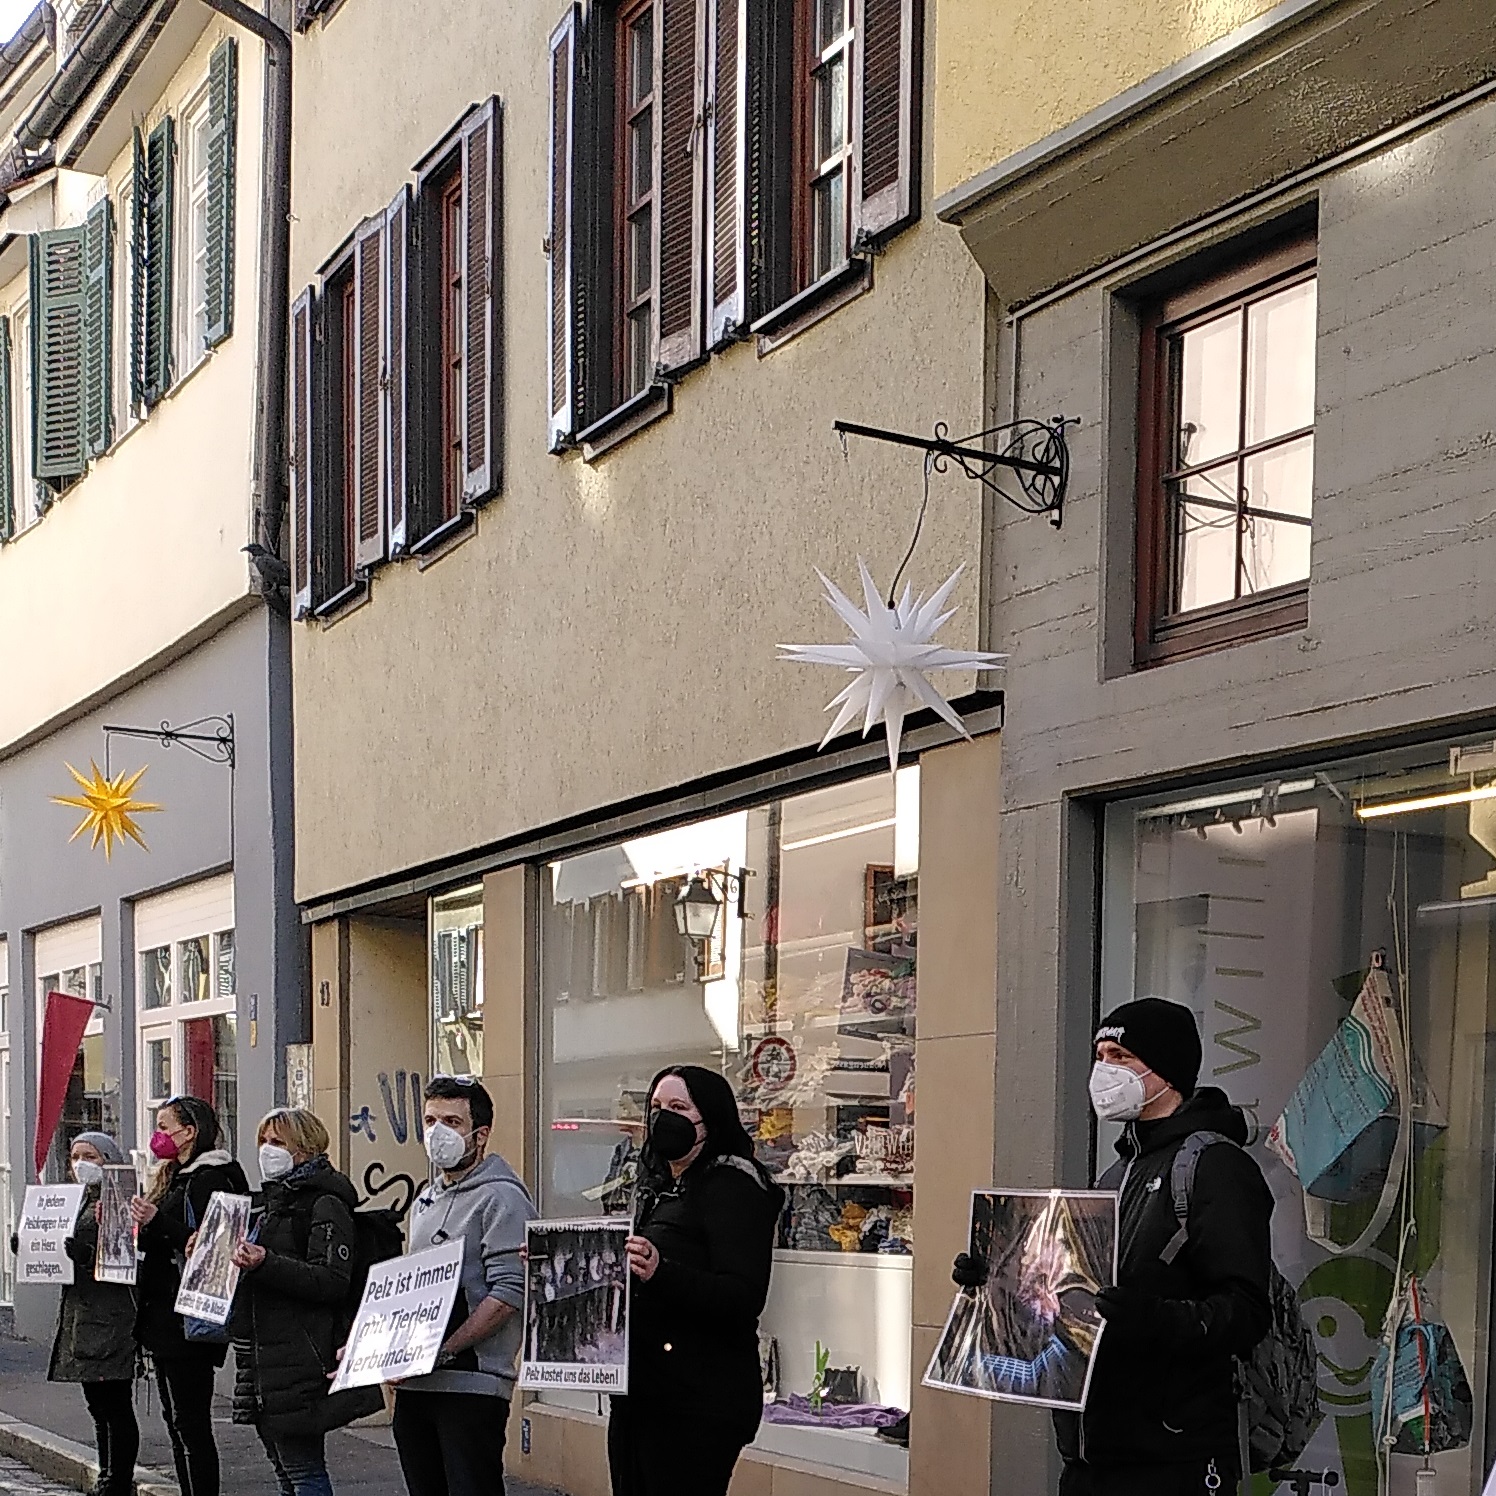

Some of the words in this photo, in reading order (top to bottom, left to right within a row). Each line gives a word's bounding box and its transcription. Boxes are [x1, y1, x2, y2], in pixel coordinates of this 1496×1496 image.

[365, 1275, 394, 1304] Pelz
[394, 1271, 413, 1296] ist
[413, 1260, 460, 1290] immer
[359, 1313, 387, 1339] mit
[388, 1297, 443, 1332] Tierleid
[345, 1344, 425, 1375] verbunden.
[525, 1366, 540, 1381] Pelz
[540, 1366, 563, 1382] kostet
[563, 1370, 577, 1383] uns
[577, 1368, 590, 1384] das
[591, 1368, 619, 1385] Leben!
